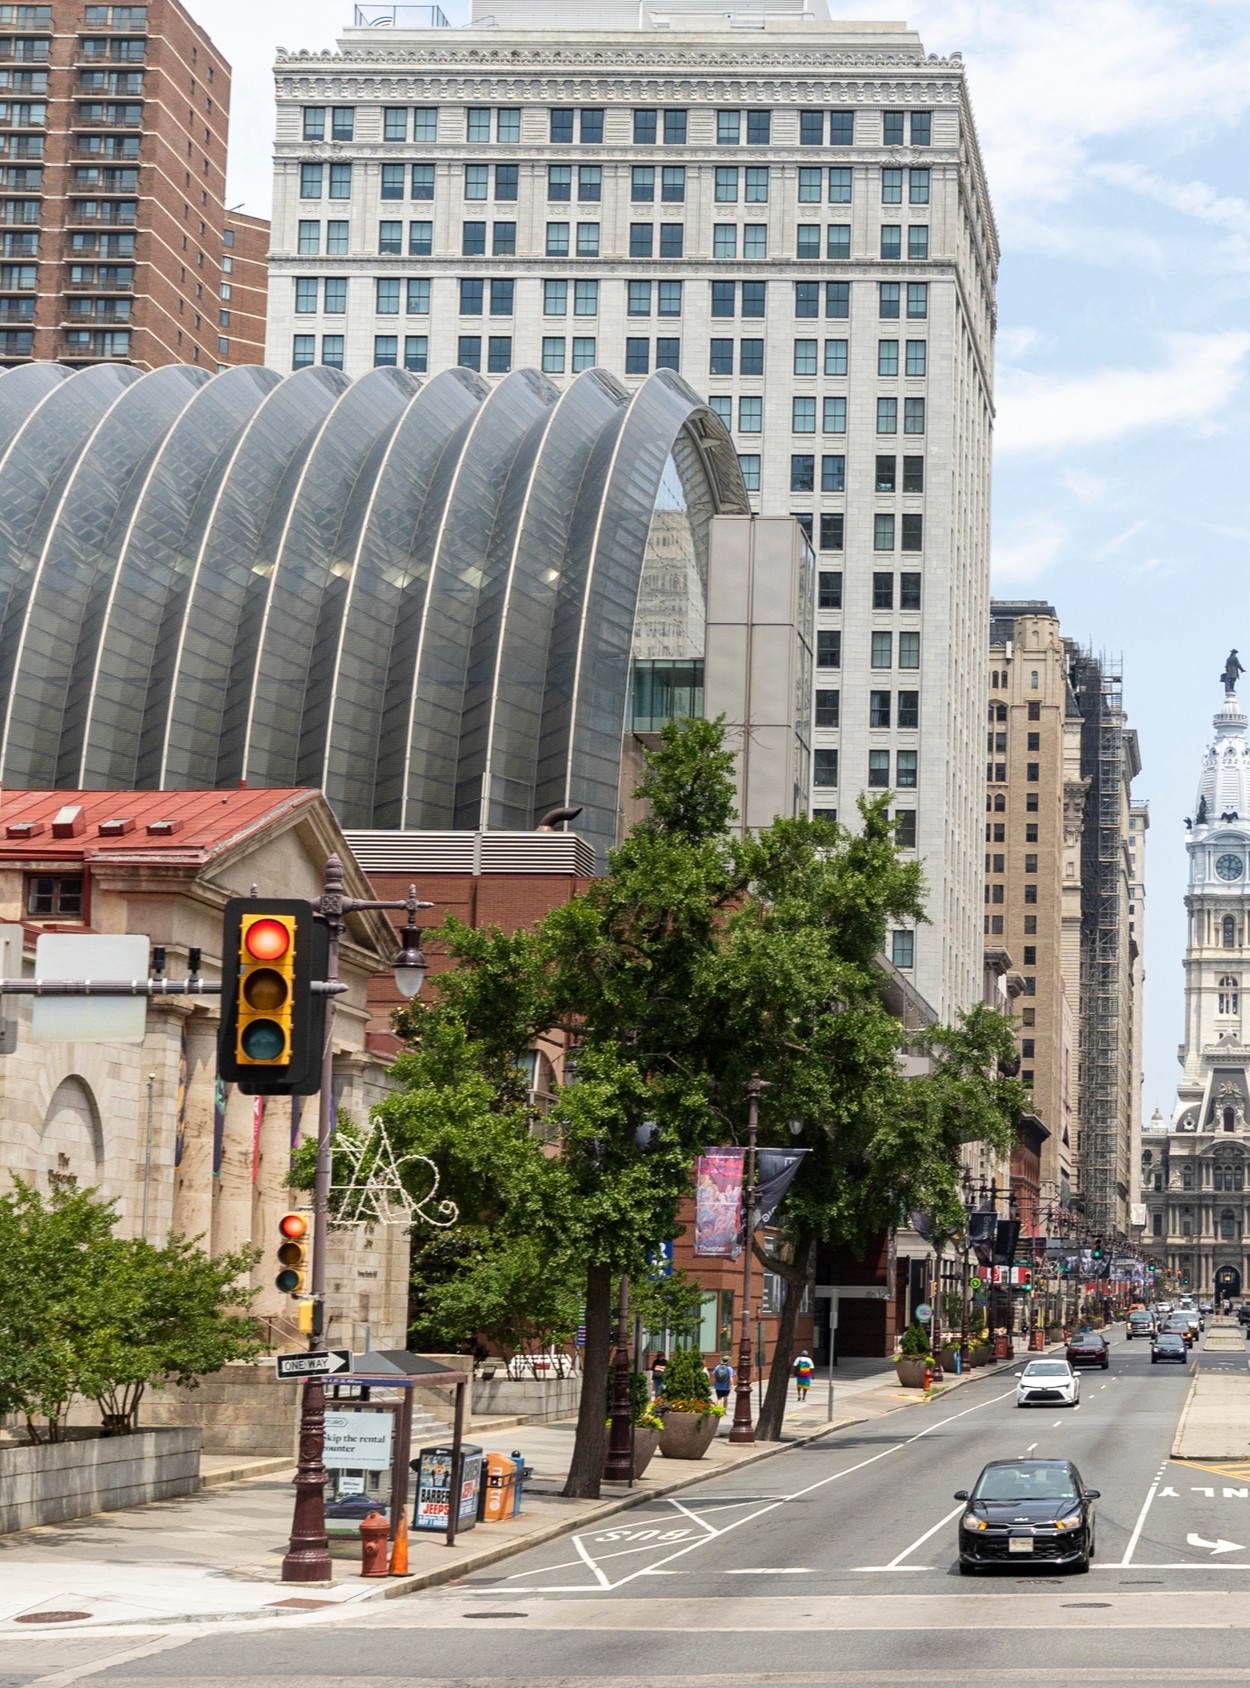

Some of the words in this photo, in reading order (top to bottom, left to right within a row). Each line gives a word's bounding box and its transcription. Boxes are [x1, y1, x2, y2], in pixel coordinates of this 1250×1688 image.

[284, 1361, 304, 1370] ONE
[308, 1359, 328, 1368] WAY
[324, 1434, 342, 1444] kip
[421, 1488, 450, 1504] BARBER
[423, 1504, 449, 1515] JEEPS
[594, 1528, 693, 1542] BUS
